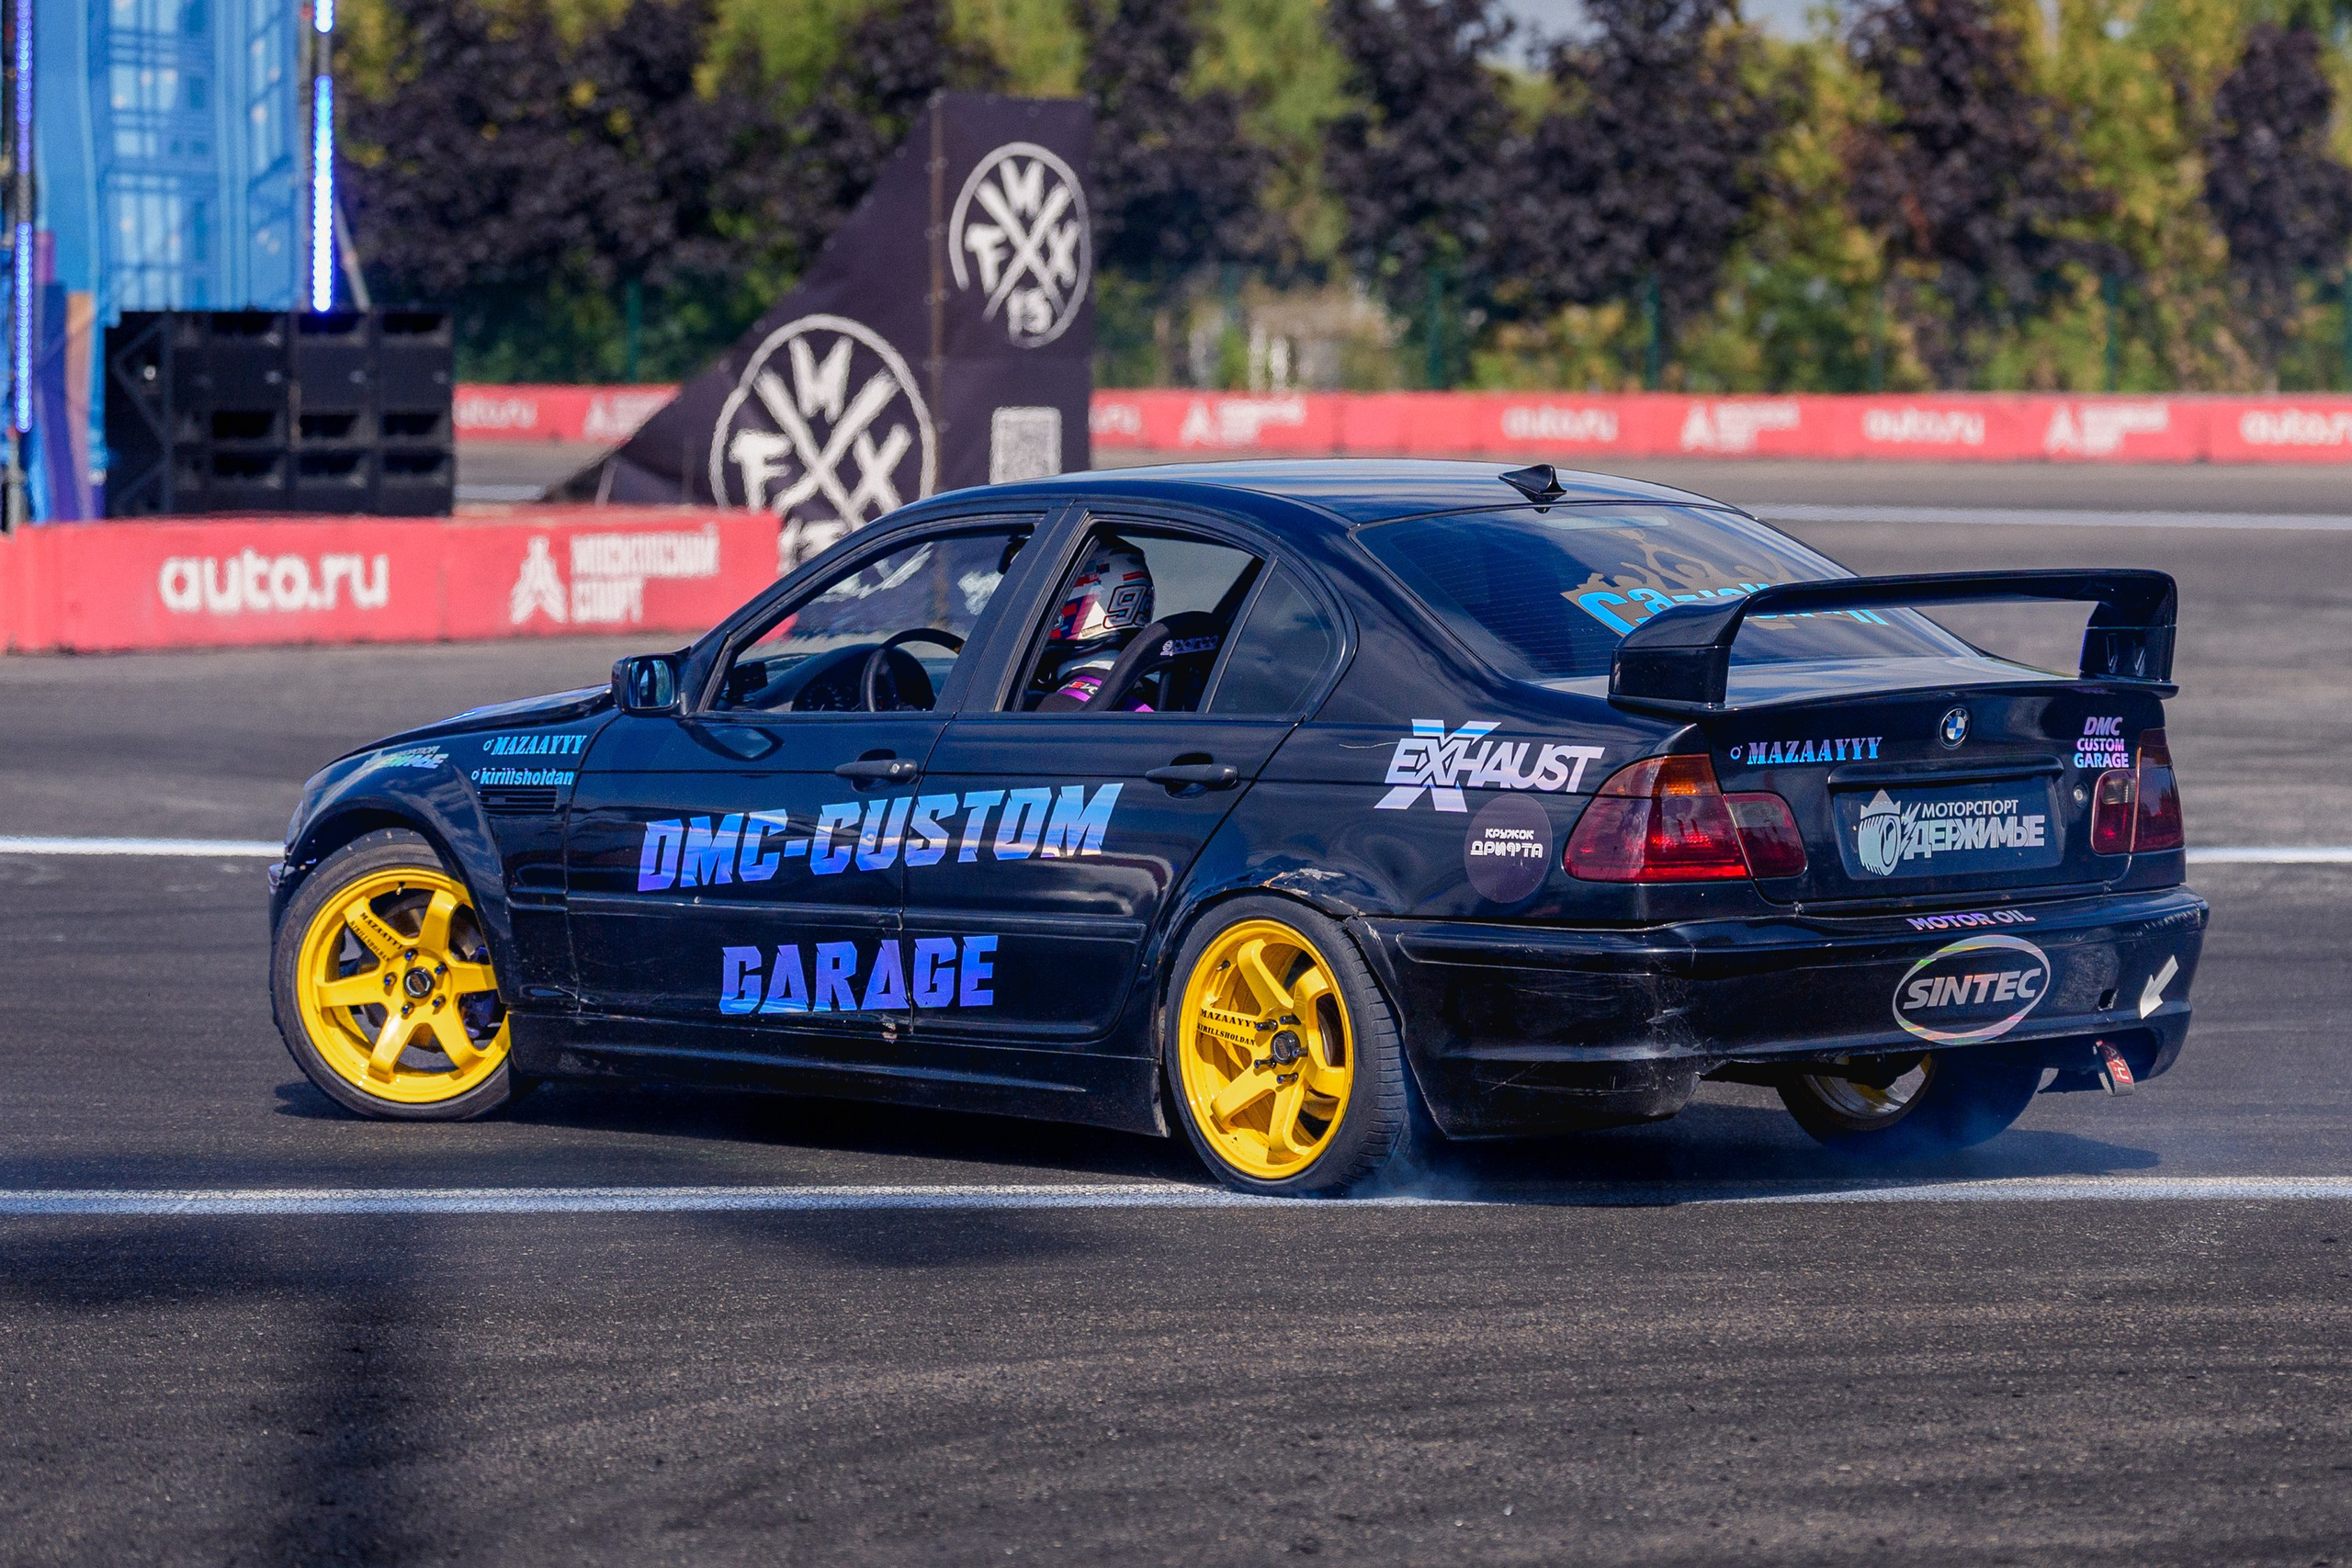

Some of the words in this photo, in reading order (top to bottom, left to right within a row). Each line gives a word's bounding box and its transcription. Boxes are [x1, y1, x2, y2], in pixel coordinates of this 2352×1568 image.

[158, 547, 389, 615] auto.ru
[2083, 716, 2123, 736] DMC
[491, 735, 587, 755] MAZAAYYY
[1747, 736, 1883, 765] MAZAAYYY
[2076, 738, 2125, 751] CUSTOM
[1374, 718, 1606, 813] EXHAUST
[2073, 752, 2130, 769] GARAGE
[1921, 799, 2019, 818] МОТОРСПОРТ
[638, 783, 1124, 892] DMC-CUSTOM
[1485, 828, 1534, 840] КРУЖОК
[1470, 840, 1544, 858] ДРИФТА
[1905, 912, 1996, 931] MOTOR
[1992, 909, 2036, 924] OIL
[718, 935, 999, 1015] GARAGE
[1903, 968, 2041, 1010] SINTEC
